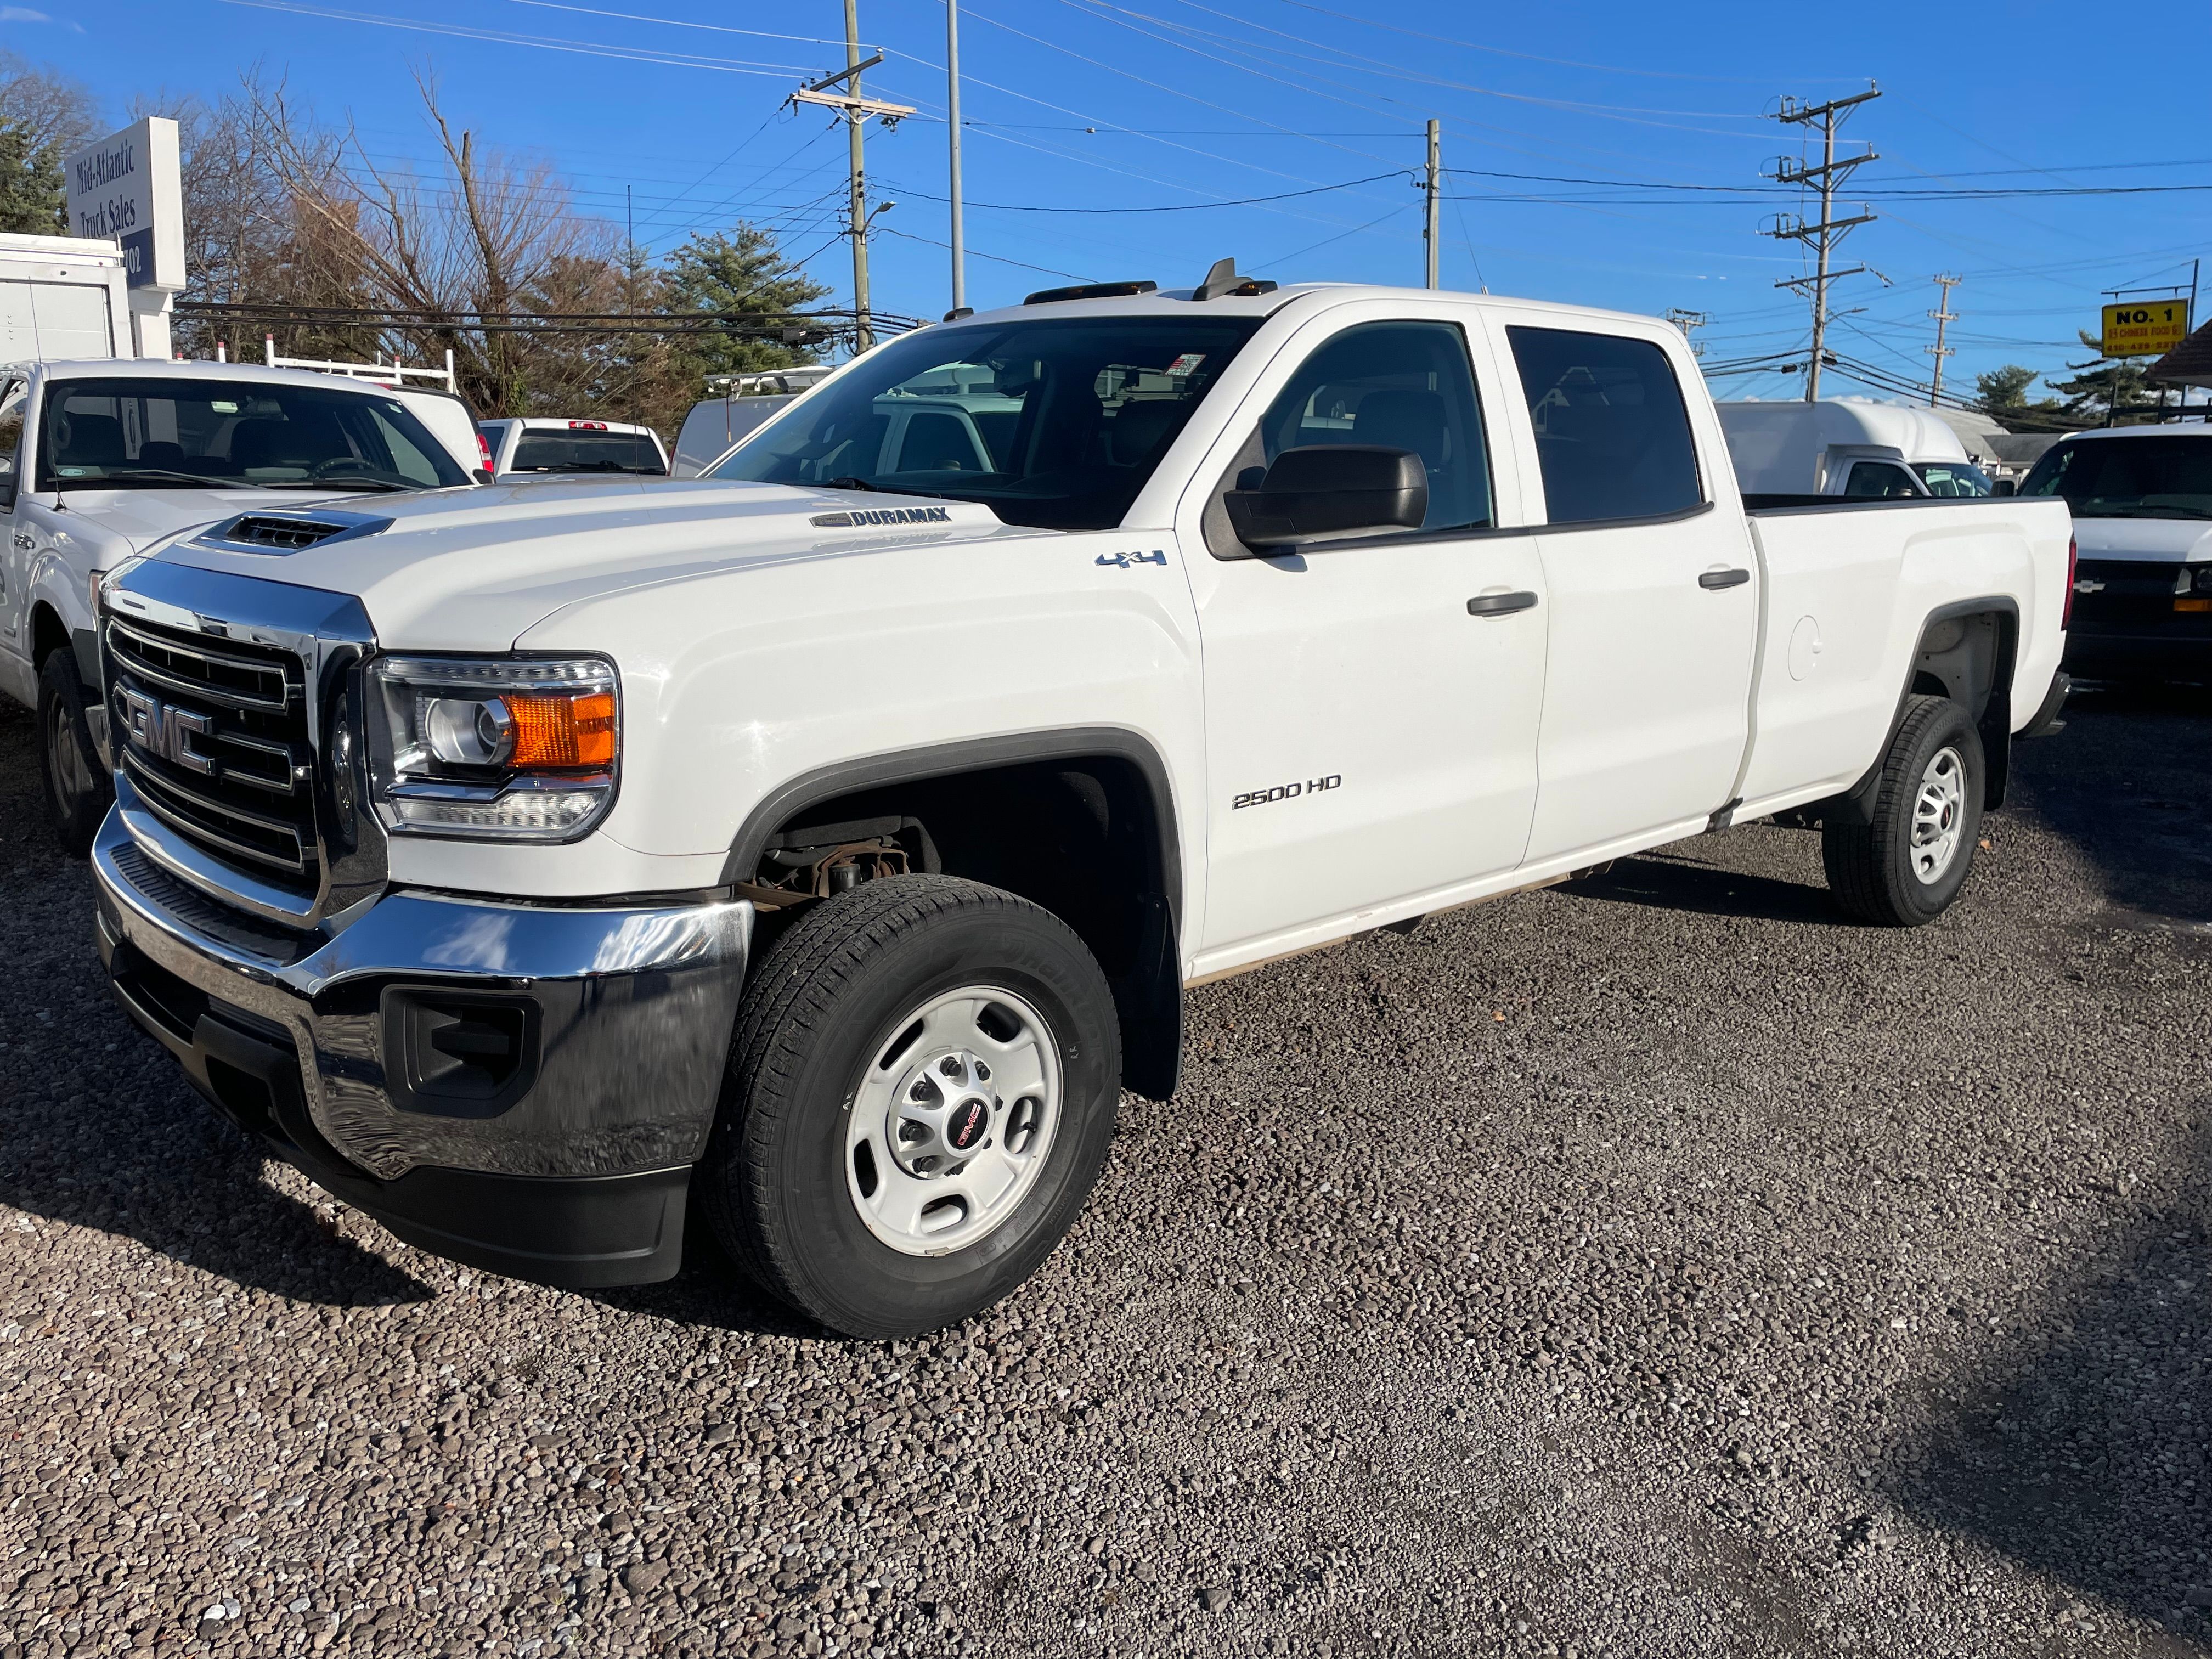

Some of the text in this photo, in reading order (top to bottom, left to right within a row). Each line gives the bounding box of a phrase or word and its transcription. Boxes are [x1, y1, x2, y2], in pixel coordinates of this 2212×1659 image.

[76, 139, 134, 196] Mid-Atlantic
[80, 194, 136, 239] Truck Sales
[2116, 308, 2172, 324] NO. 1
[851, 507, 952, 527] DURAMAX
[127, 689, 216, 776] GMC
[1232, 774, 1341, 810] 2500 HD
[957, 1103, 982, 1147] GMC
